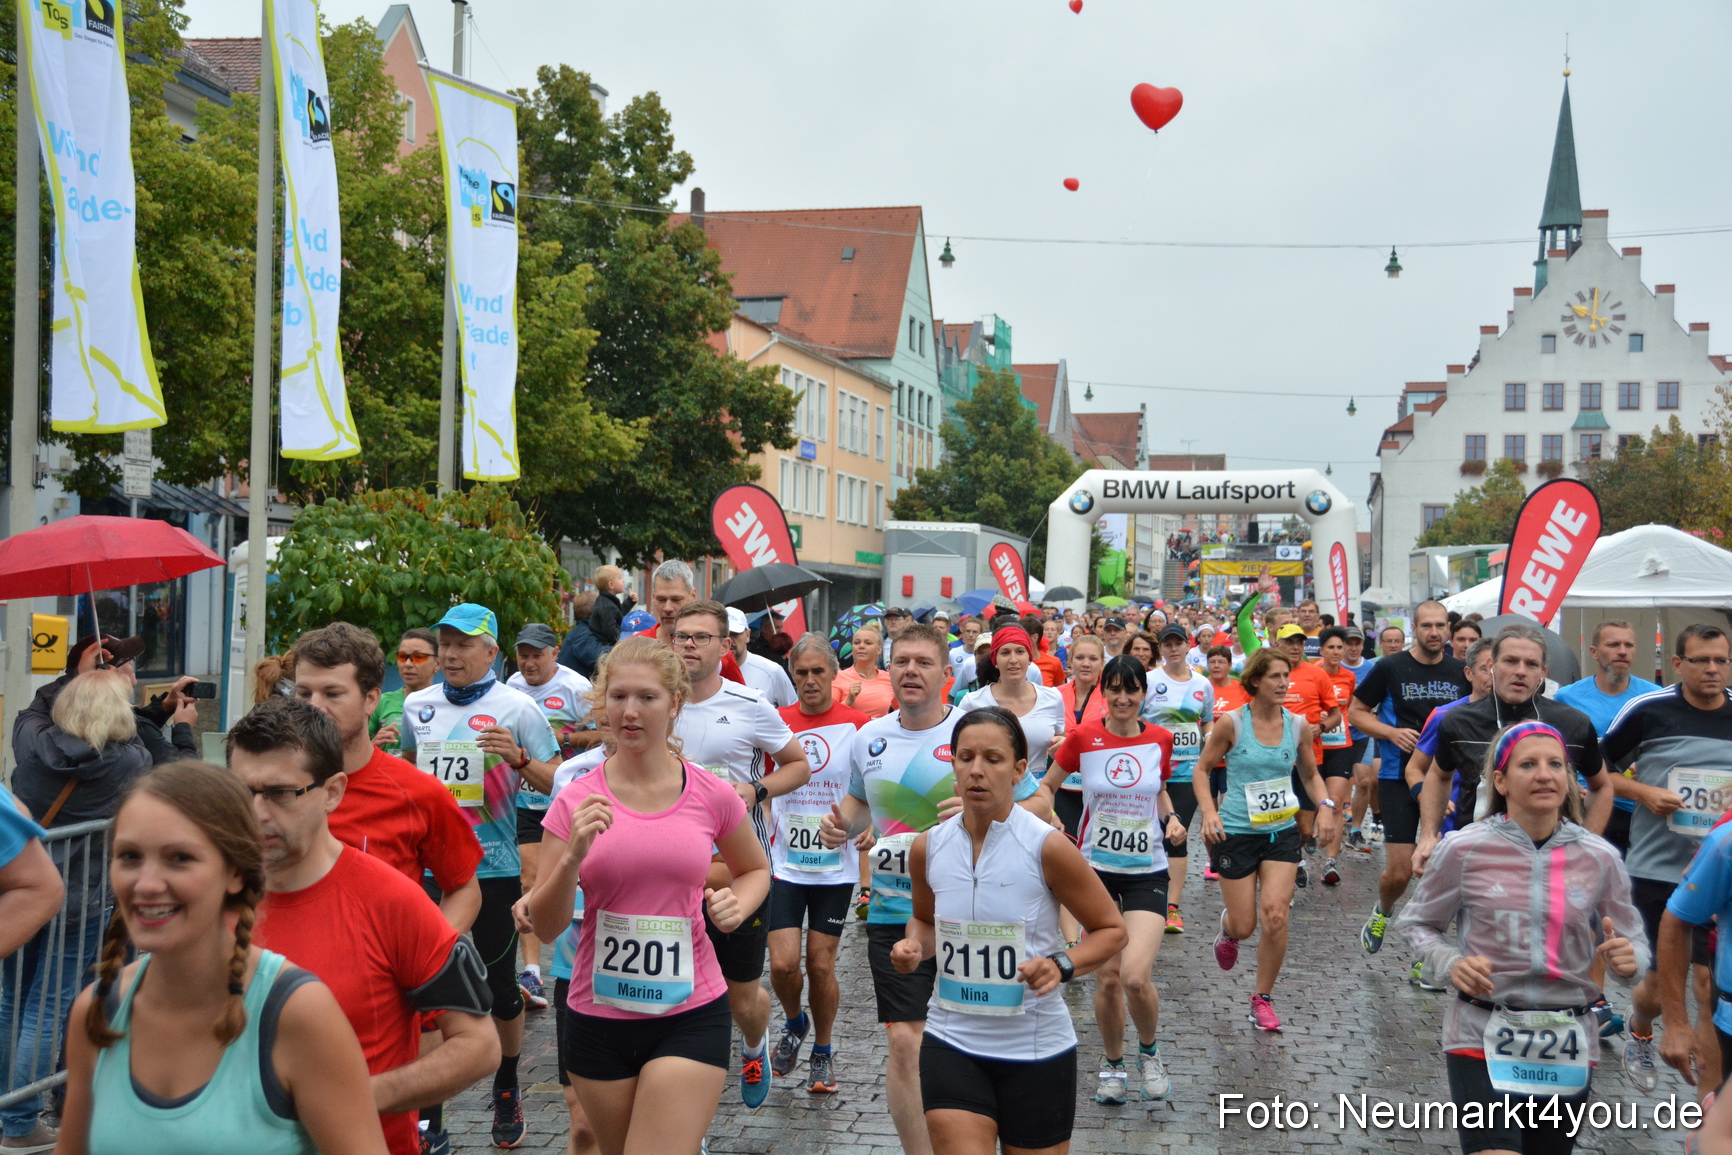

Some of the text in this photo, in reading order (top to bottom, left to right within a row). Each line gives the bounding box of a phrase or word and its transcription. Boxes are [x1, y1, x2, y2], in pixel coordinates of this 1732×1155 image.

[1103, 479, 1296, 504] BMW Laufsport
[1509, 499, 1587, 621] REWE
[1332, 551, 1347, 612] REWE
[1173, 732, 1197, 746] 650
[430, 757, 469, 781] 173
[1258, 789, 1287, 812] 327
[789, 827, 835, 850] 204
[1097, 826, 1148, 853] 2048
[800, 855, 822, 864] Josef
[877, 848, 906, 874] 21
[895, 878, 912, 890] Fra
[636, 920, 683, 932] BOCK
[967, 924, 1015, 936] BOCK
[602, 936, 680, 976] 2201
[942, 941, 1017, 980] 2110
[617, 982, 662, 1000] Marina
[961, 986, 989, 1002] Nina
[1495, 1027, 1580, 1060] 2724
[1512, 1065, 1558, 1082] Sandra
